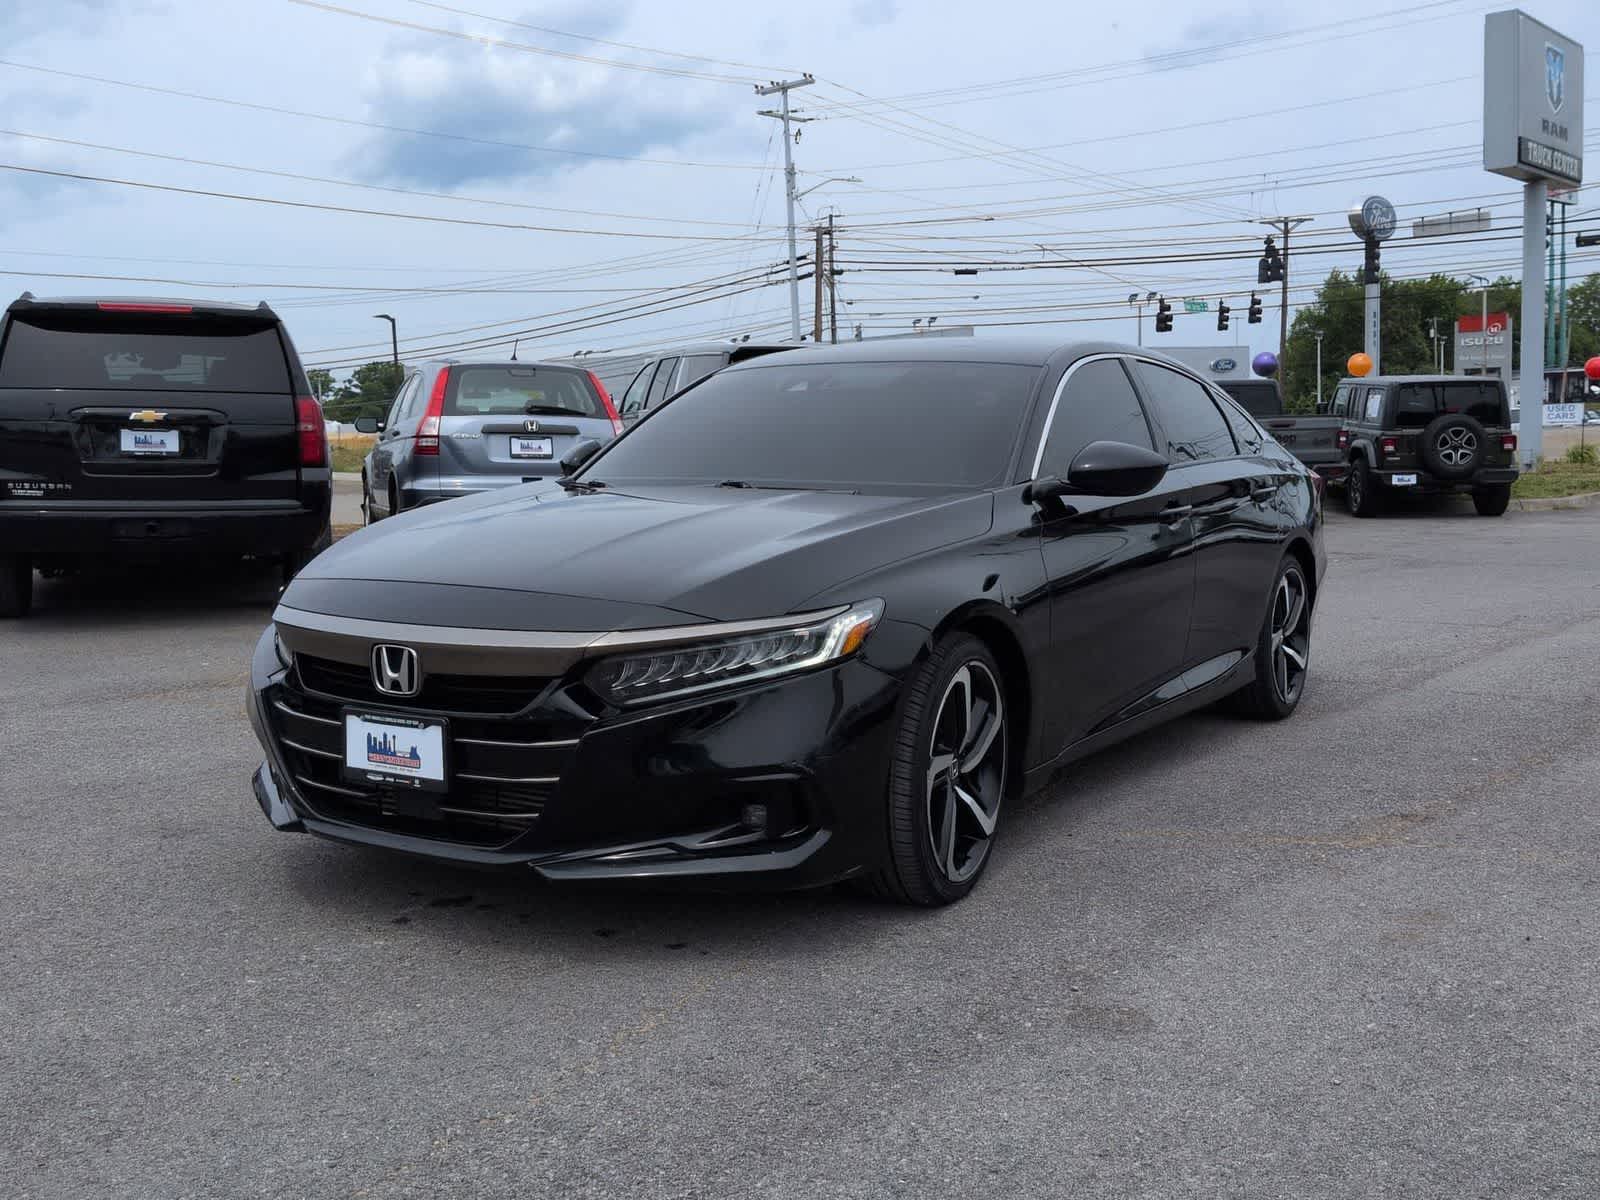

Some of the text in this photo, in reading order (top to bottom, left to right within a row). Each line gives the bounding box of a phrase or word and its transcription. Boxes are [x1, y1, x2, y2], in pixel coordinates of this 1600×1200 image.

[1541, 118, 1568, 142] RAM
[1527, 141, 1578, 179] TRUCK CENTER
[1547, 412, 1576, 420] CARS
[8, 482, 72, 490] SUBURBAN
